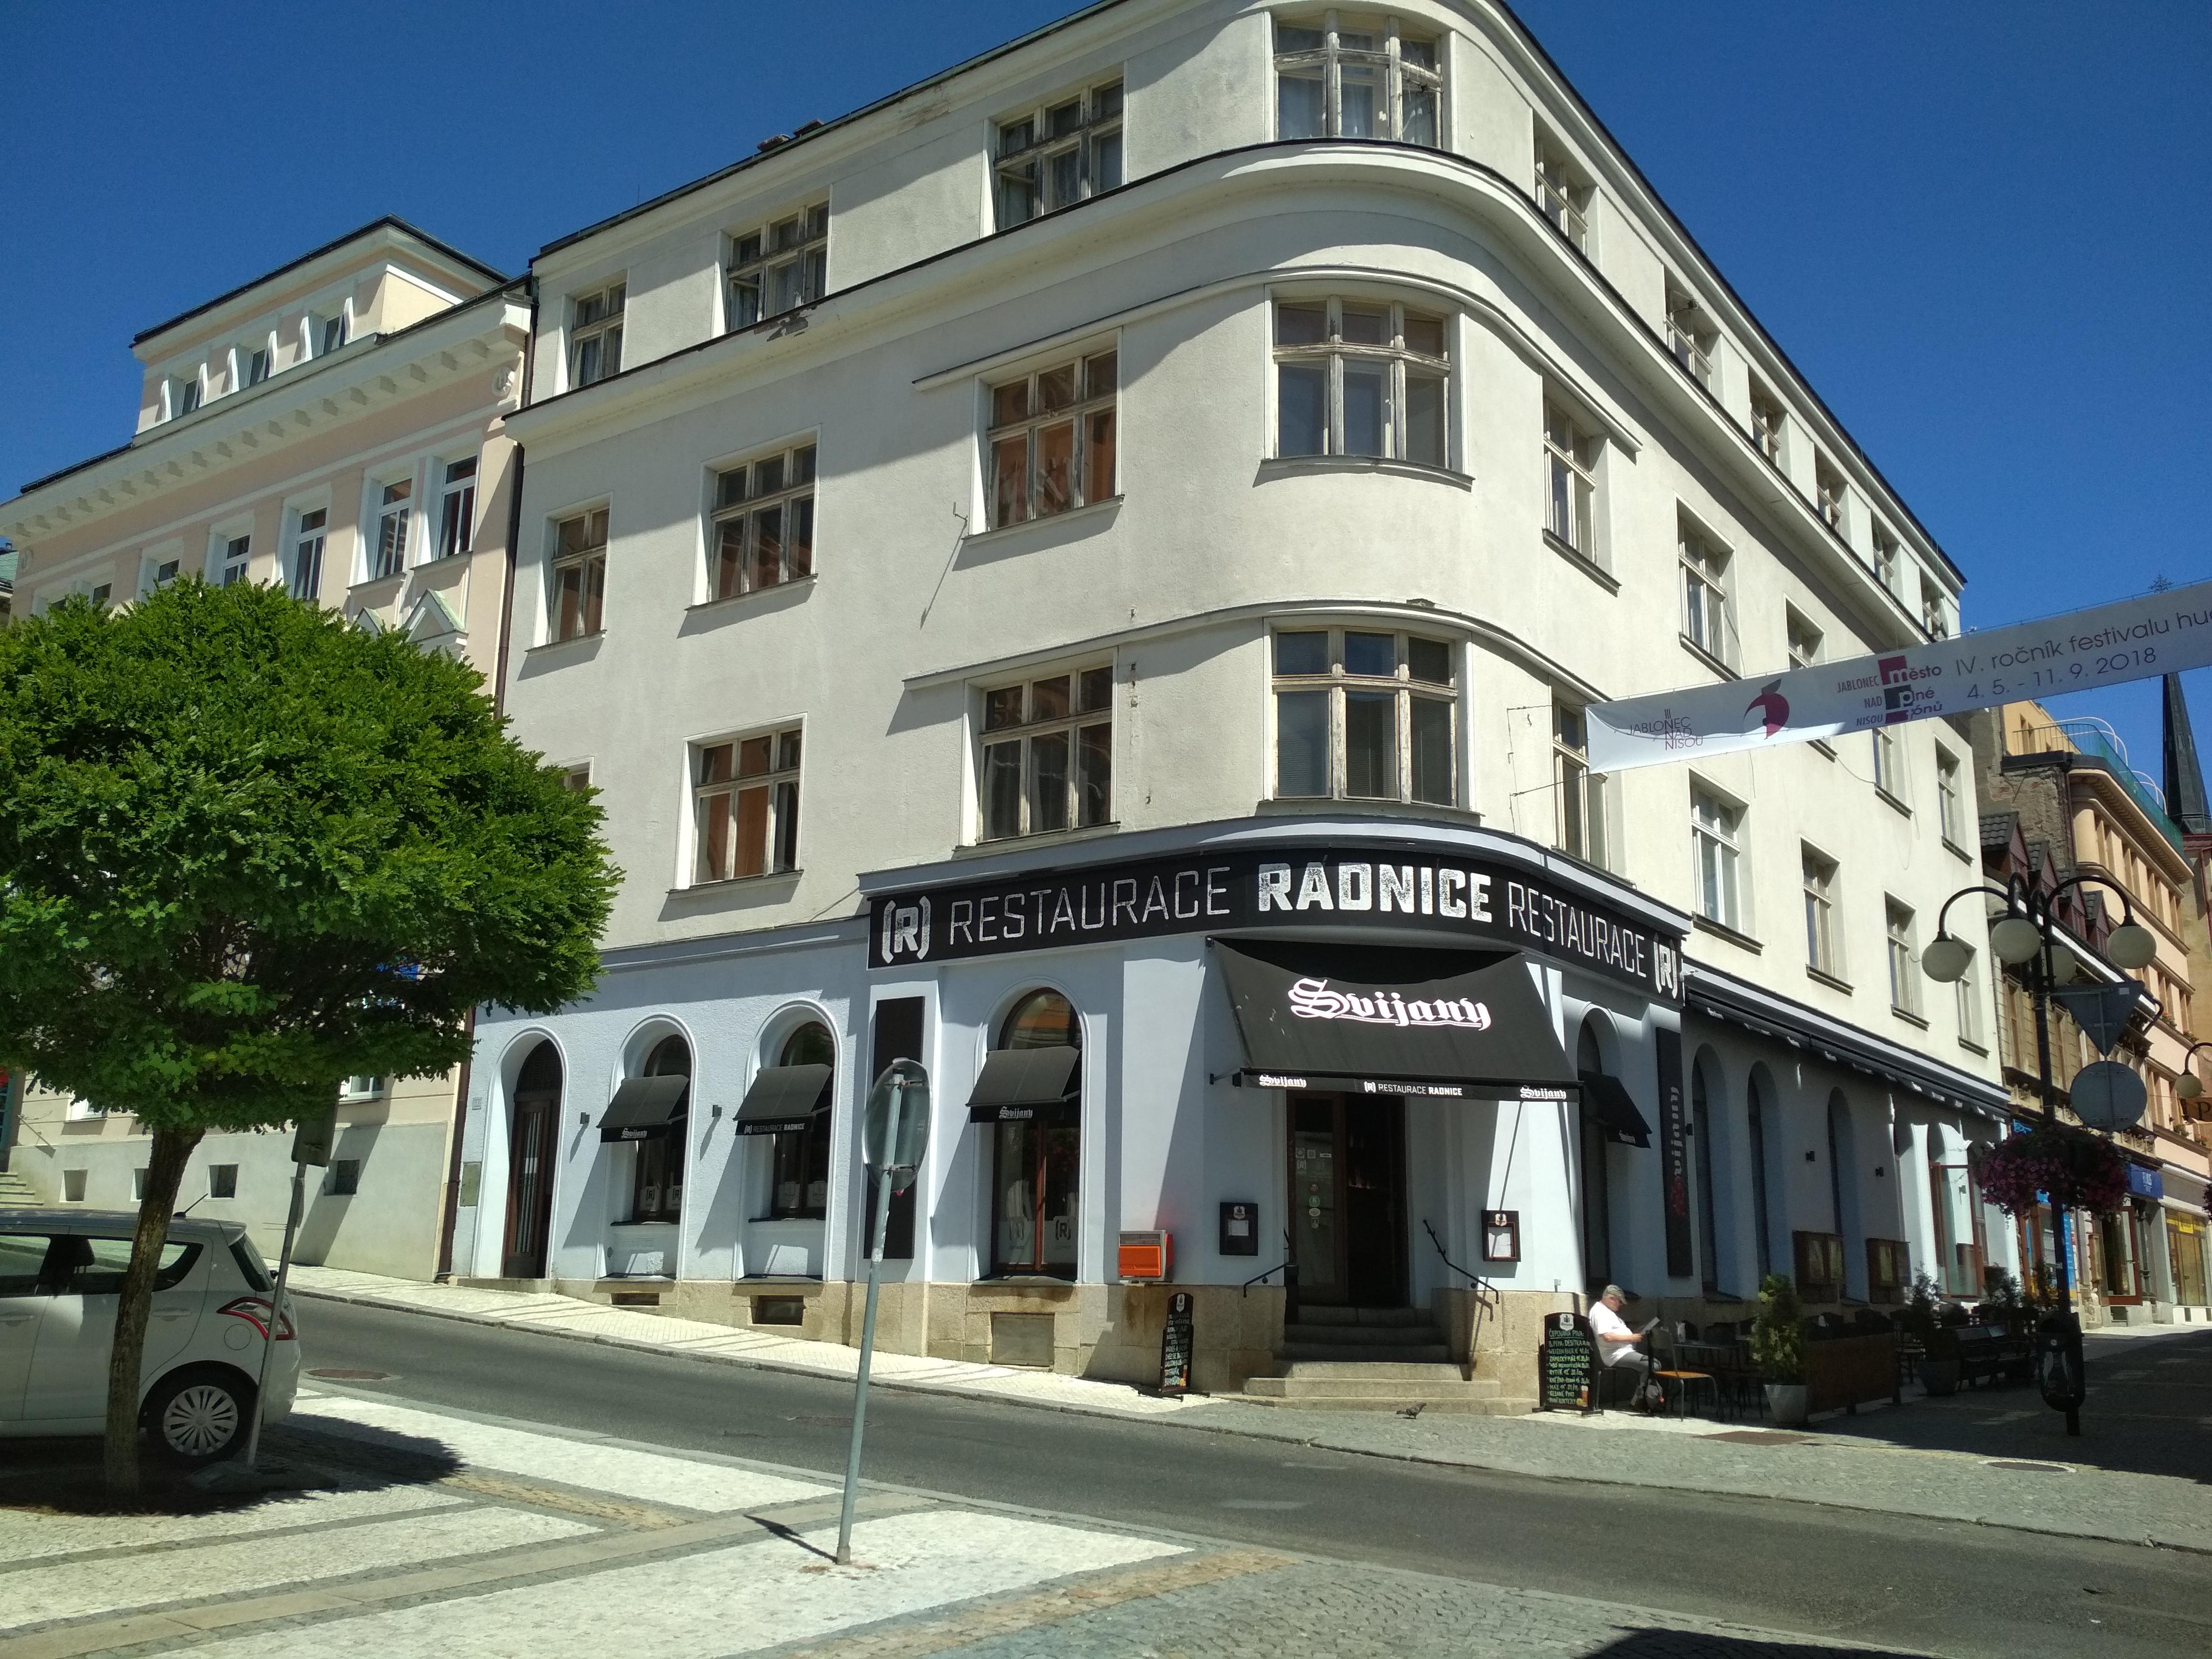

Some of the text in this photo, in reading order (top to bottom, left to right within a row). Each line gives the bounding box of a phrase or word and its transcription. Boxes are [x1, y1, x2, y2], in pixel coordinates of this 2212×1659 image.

[1956, 609, 2212, 676] IV. ročník festivalu hu
[2096, 647, 2157, 675] 2018
[1888, 665, 1942, 684] město
[1838, 675, 1879, 693] JABLONEC
[1864, 695, 1882, 708] NAD
[1630, 717, 1691, 735] JABLONEC
[1856, 713, 1883, 726] NISOU
[1665, 727, 1693, 740] NAD
[1665, 736, 1704, 750] NISOU
[950, 866, 1231, 945] RESTAURACE
[1258, 862, 1493, 923] RADNICE
[1508, 881, 1647, 978] RESTAURACE
[1287, 977, 1491, 1031] Svijany
[1259, 1074, 1307, 1088] Svijany
[1378, 1083, 1427, 1095] RESTAURACE
[1428, 1086, 1463, 1097] RADNICE
[1520, 1085, 1567, 1100] Svijany
[999, 1106, 1033, 1119] Svijany
[621, 1128, 648, 1139] Svijany
[753, 1124, 783, 1133] RESTAURACE
[784, 1123, 805, 1131] RADNICE
[1668, 1086, 1686, 1216] vijany
